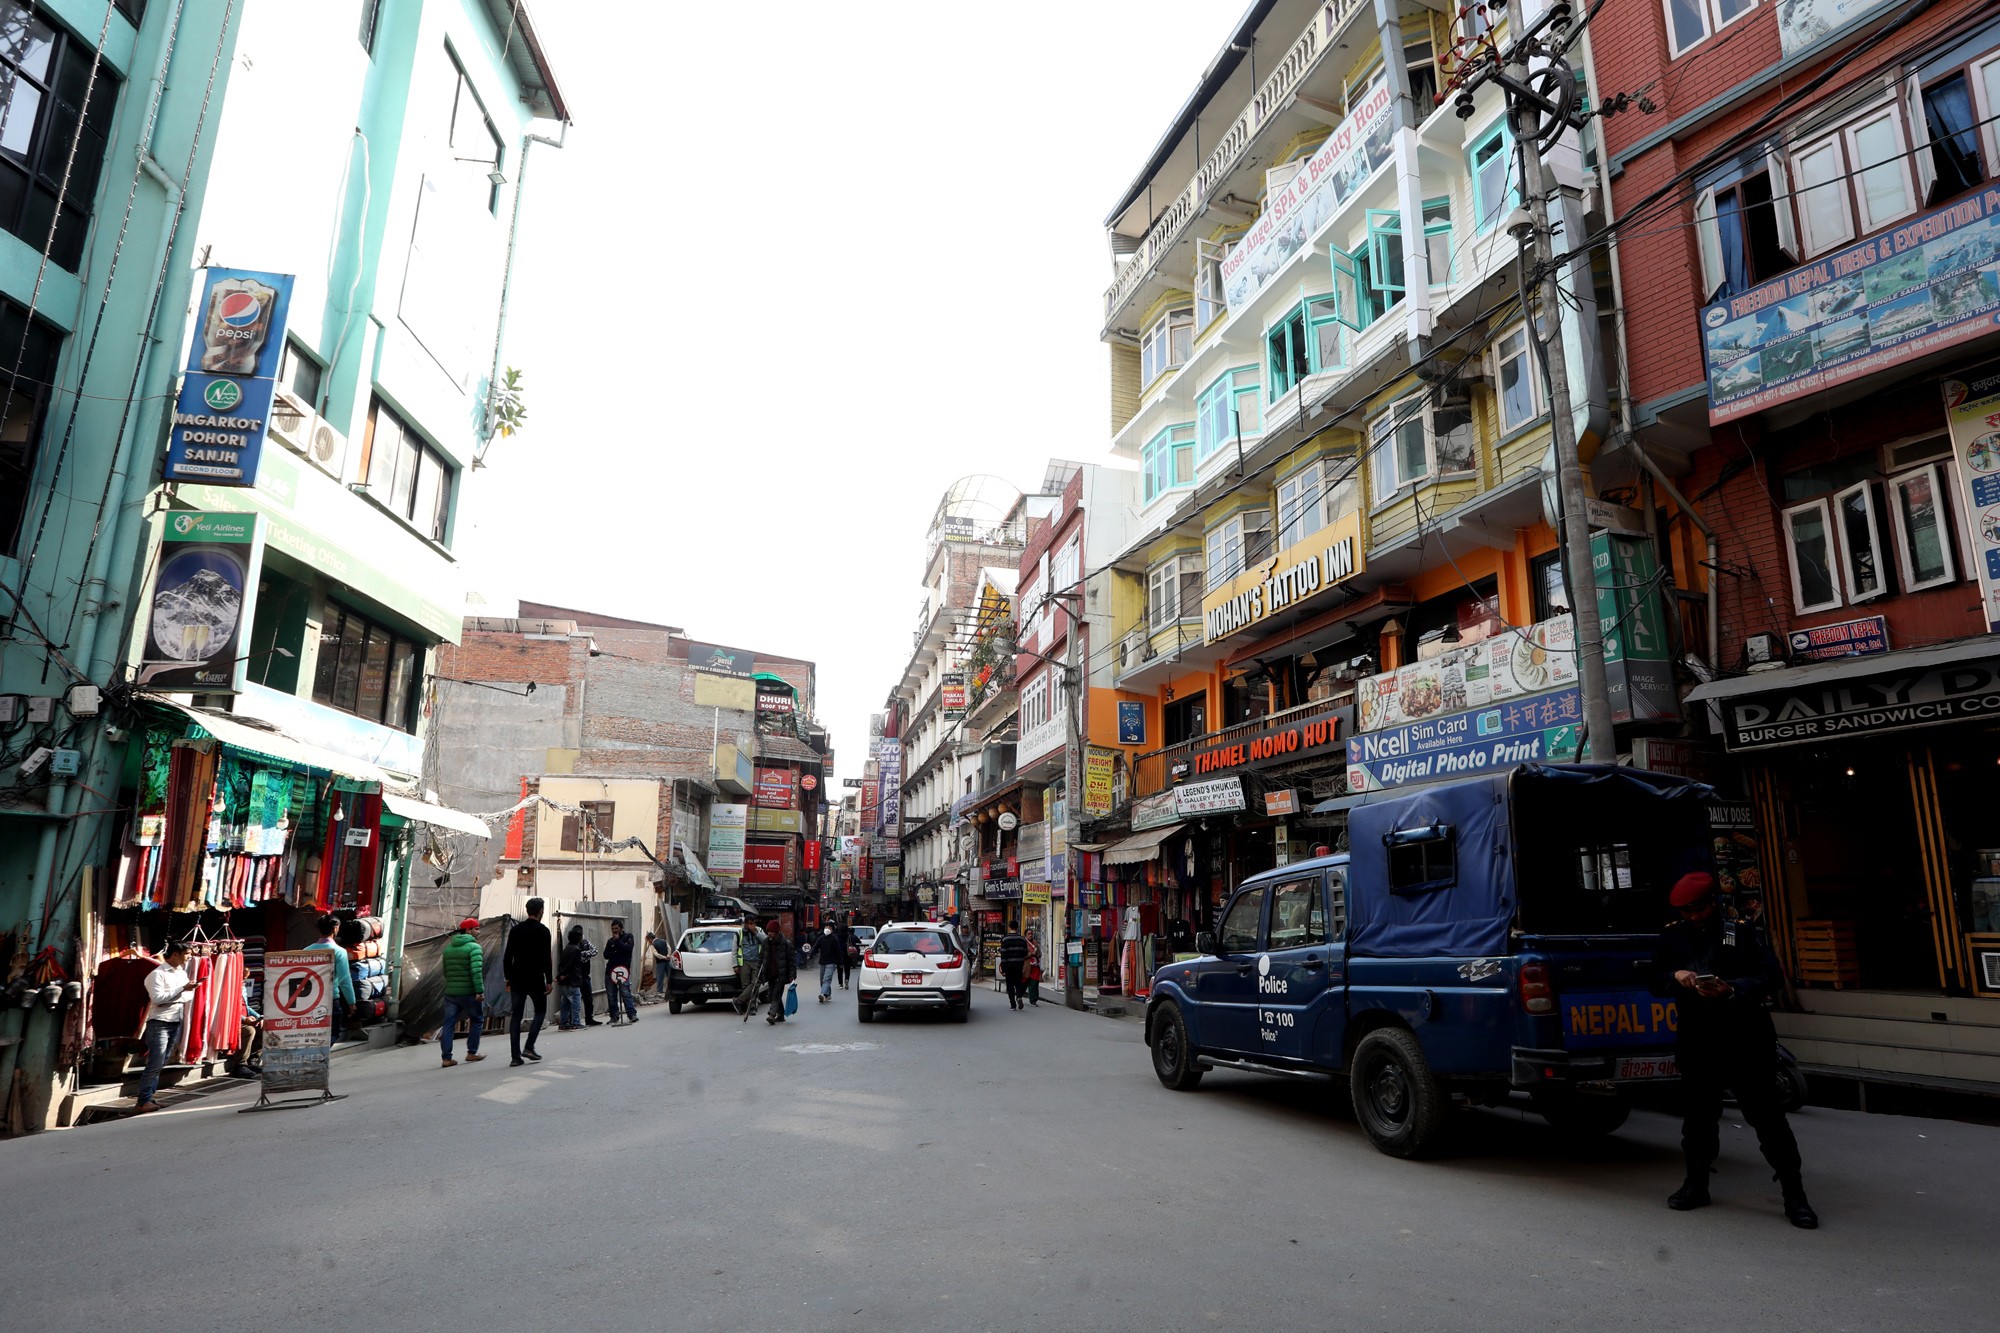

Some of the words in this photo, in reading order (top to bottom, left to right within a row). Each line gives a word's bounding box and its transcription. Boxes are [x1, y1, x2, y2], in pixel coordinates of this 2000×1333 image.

[1374, 106, 1392, 129] FLOOR
[1222, 250, 1245, 280] Rose
[1246, 212, 1274, 254] Angel
[1274, 188, 1297, 221] SPA
[1298, 176, 1308, 194] &
[1308, 131, 1351, 184] Beauty
[1730, 280, 1786, 318] FREEDOM
[1790, 266, 1830, 298] NEPAL
[1832, 244, 1877, 278] TREKS
[1879, 237, 1892, 258] &
[1894, 199, 1982, 252] EXPEDITION
[1984, 189, 2000, 214] P
[1930, 266, 1967, 286] MOUNTAIN
[1968, 256, 1995, 270] FLIGHT
[1867, 293, 1898, 310] JUNGLE
[1900, 282, 1929, 297] SAFARI
[1822, 310, 1854, 326] RAFTING
[1937, 311, 1973, 328] BHUTAN
[1975, 302, 2000, 314] TOUR
[216, 328, 255, 340] pepsi
[1765, 329, 1806, 348] EXPEDITION
[1880, 335, 1903, 349] TIBET
[1906, 327, 1928, 340] TOUR
[1718, 350, 1750, 366] TREKKING
[1818, 356, 1848, 371] LUMBINI
[1850, 348, 1871, 358] TOUR
[1766, 375, 1790, 388] BUNGY
[1792, 368, 1812, 380] JUMP
[1715, 394, 1736, 406] ULTRA
[1737, 386, 1760, 399] FLIGHT
[174, 413, 262, 432] NAGARKOT
[182, 430, 248, 448] DOHORI
[184, 448, 238, 464] SANJH
[202, 486, 239, 511] Sales
[212, 524, 245, 532] Airlines
[267, 519, 318, 561] Ticketing
[318, 548, 348, 573] Office
[1206, 585, 1262, 642] MOHAN'S
[1266, 555, 1319, 612] TATTOO
[1323, 536, 1353, 584] INN
[1618, 542, 1652, 652] DIGITAL
[1550, 624, 1568, 634] OVER
[1809, 624, 1849, 646] FREEDOM
[1850, 618, 1880, 639] NEPAL
[1492, 648, 1511, 658] COOKING
[1820, 643, 1854, 660] EXPEDITION
[1868, 638, 1884, 650] Ltd.
[1492, 655, 1508, 664] CLASS
[1492, 662, 1510, 670] EVERYDAY
[1632, 675, 1656, 683] IMAGE
[1640, 682, 1671, 692] SERVICE
[760, 694, 791, 705] DHURI
[1736, 678, 1911, 726] DAILY
[1412, 720, 1436, 742] Sim
[1438, 716, 1468, 734] Card
[1739, 722, 1819, 744] BURGER
[1824, 702, 1954, 731] SANDWICH
[1034, 730, 1048, 748] Seven
[1048, 724, 1058, 740] Star
[1194, 743, 1247, 775] THAMEL
[1250, 729, 1298, 762] MOMO
[1303, 716, 1339, 748] HUT
[1364, 730, 1410, 760] Ncell
[1417, 738, 1446, 750] Available
[1447, 735, 1463, 744] Here
[881, 744, 900, 754] ZTO
[1088, 748, 1113, 758] MOONLIGHT
[1649, 742, 1676, 761] INSTANT
[1088, 758, 1112, 766] FREIGHT
[1381, 756, 1433, 784] Digital
[1436, 748, 1487, 774] Photo
[1491, 736, 1540, 766] Print
[1090, 780, 1108, 790] DHL
[1182, 785, 1210, 797] LEGEND'S
[1211, 780, 1241, 792] KHUKURI
[885, 776, 899, 824] 中通快递
[1086, 801, 1110, 809] ARAMEX
[1087, 792, 1109, 802] TNT
[1184, 796, 1211, 804] GALLERY
[1730, 807, 1752, 822] DOSE
[984, 880, 1000, 892] Gem's
[1000, 880, 1019, 894] Empire
[1026, 882, 1050, 892] LAUNDRY
[270, 956, 285, 964] NO
[287, 954, 330, 964] PARKING
[1259, 976, 1288, 994] Police
[1276, 1012, 1294, 1027] 100
[1570, 1004, 1646, 1036] NEPAL
